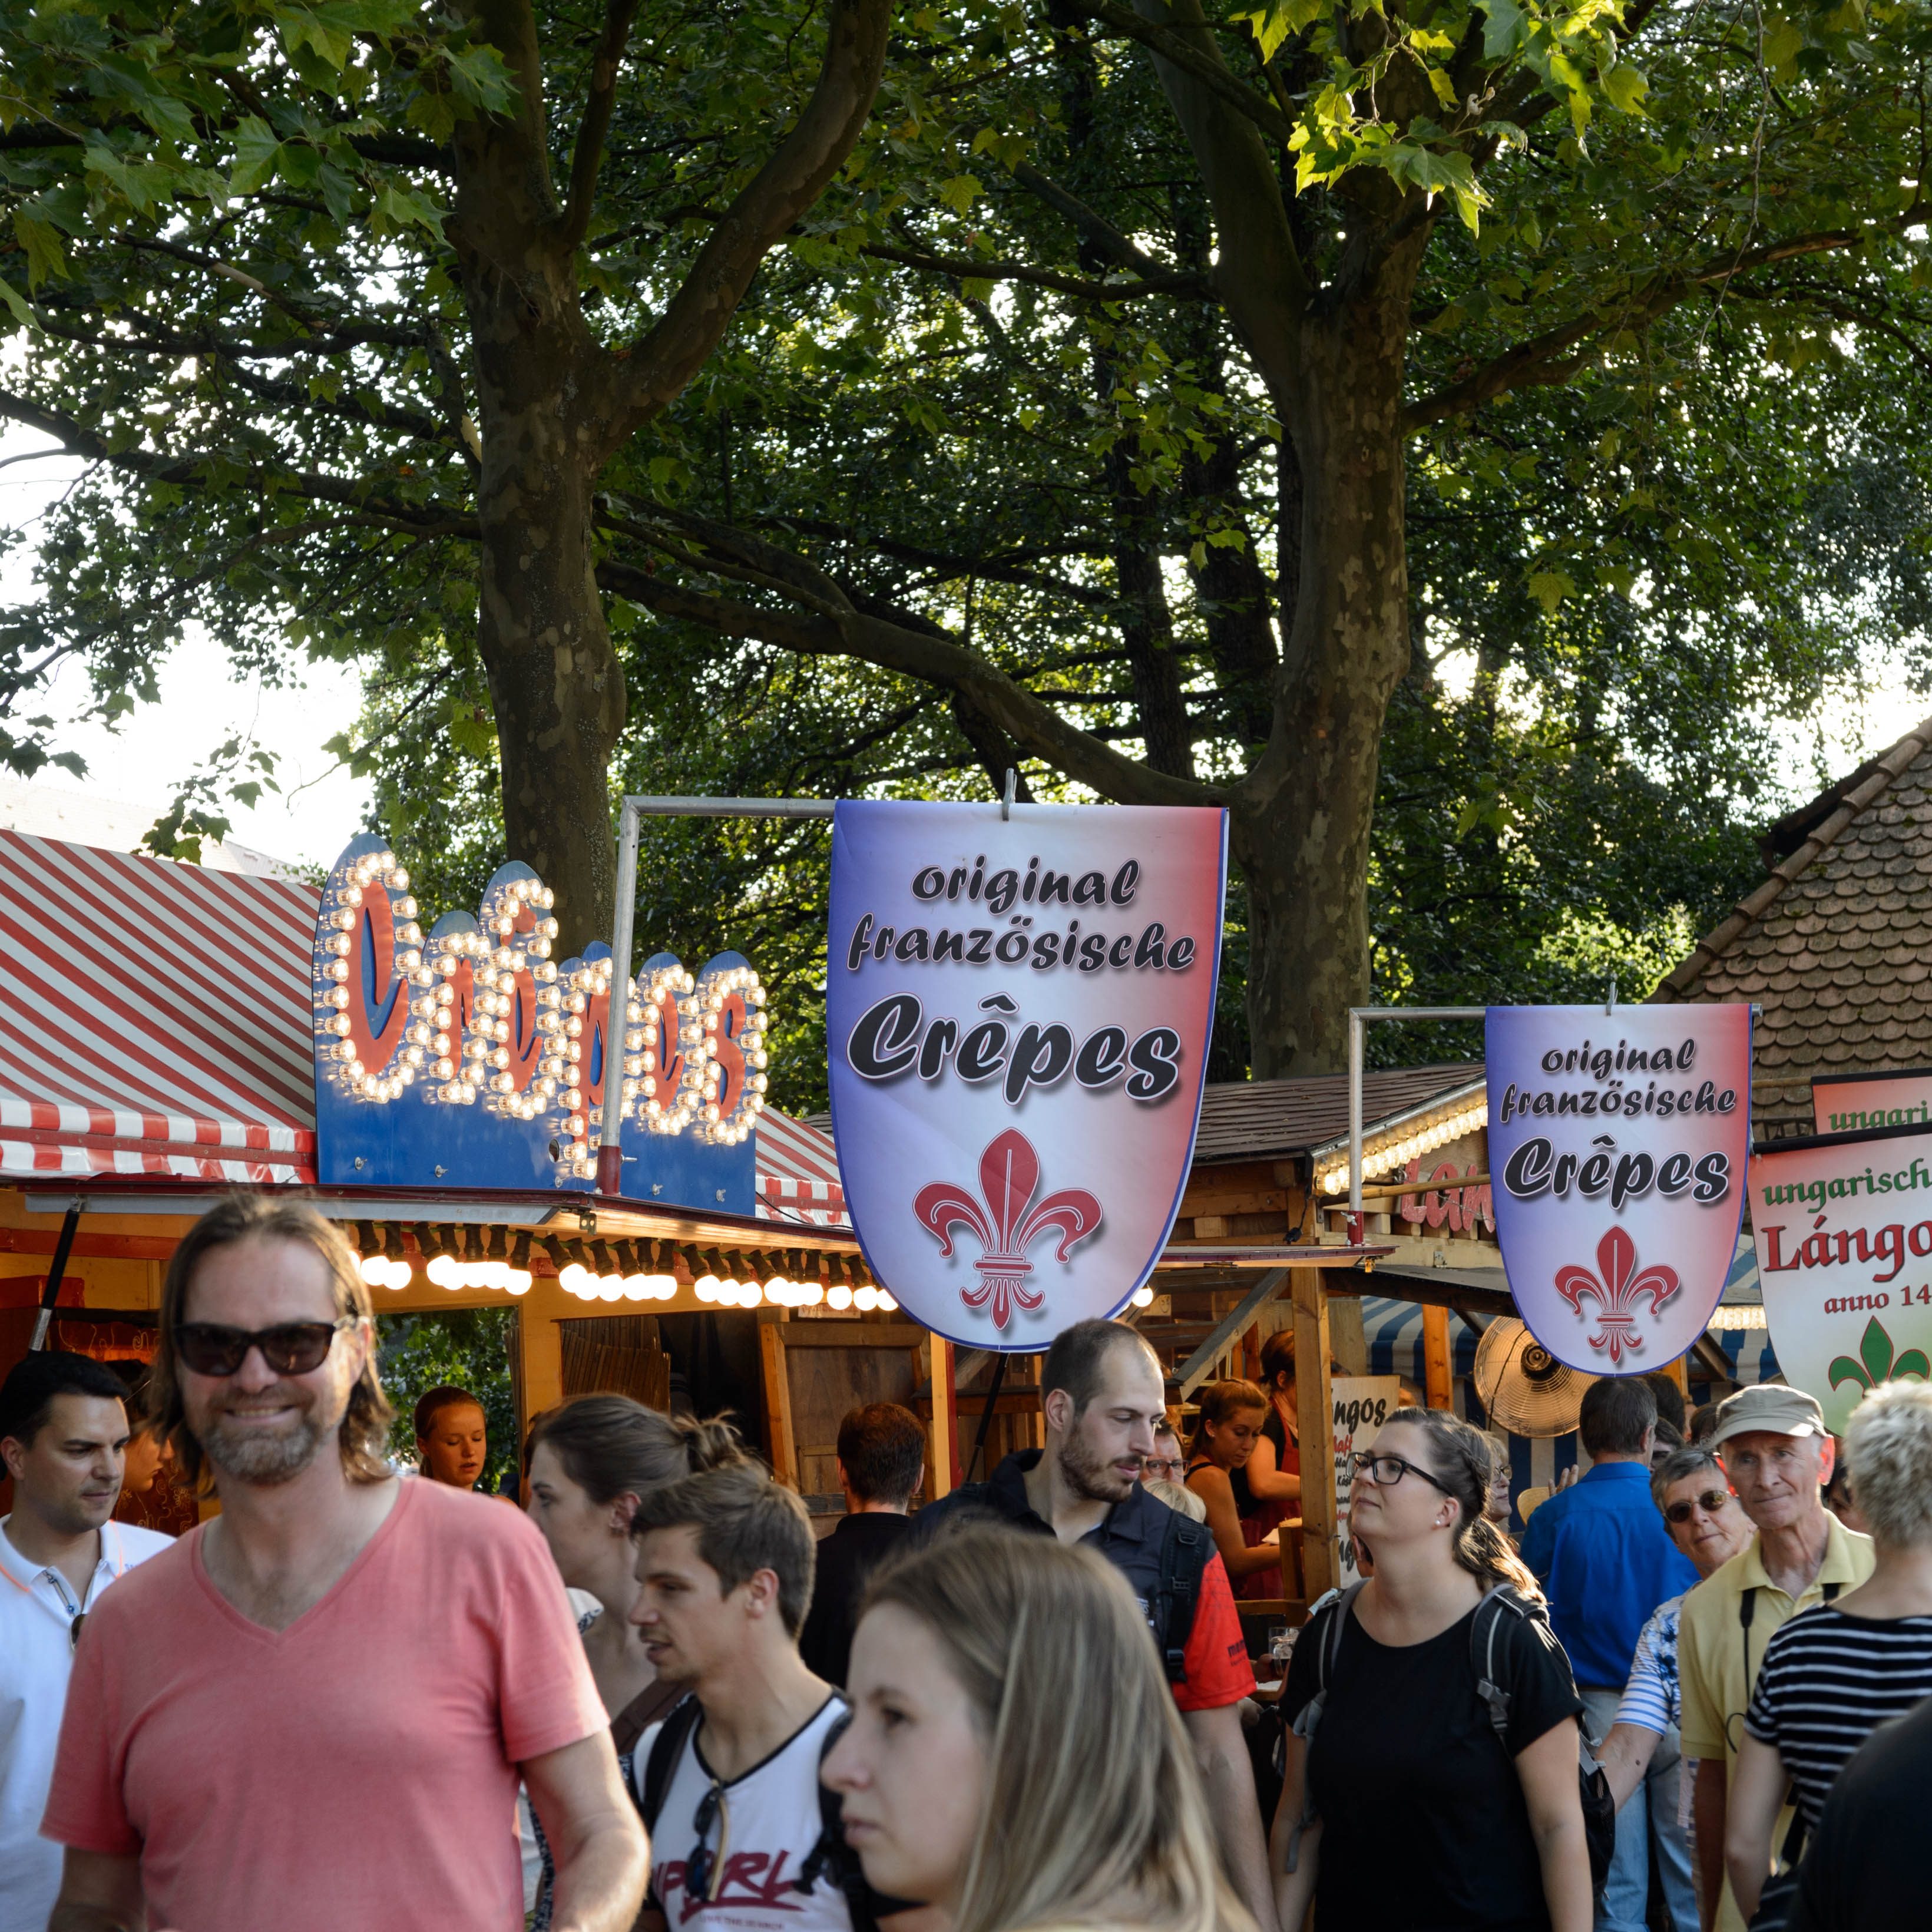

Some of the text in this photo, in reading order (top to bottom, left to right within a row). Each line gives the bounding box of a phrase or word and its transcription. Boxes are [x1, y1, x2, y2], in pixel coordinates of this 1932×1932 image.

[912, 855, 1140, 915] original
[846, 912, 1195, 972] französische
[846, 991, 1182, 1106] Crêpes
[1541, 1037, 1696, 1080] original
[1500, 1080, 1736, 1123] französische
[1503, 1132, 1729, 1211] Crêpes
[1761, 1157, 1932, 1213] ungarisch
[1760, 1215, 1932, 1283] Lángo
[1824, 1292, 1890, 1315] anno
[1333, 1397, 1387, 1435] ngos
